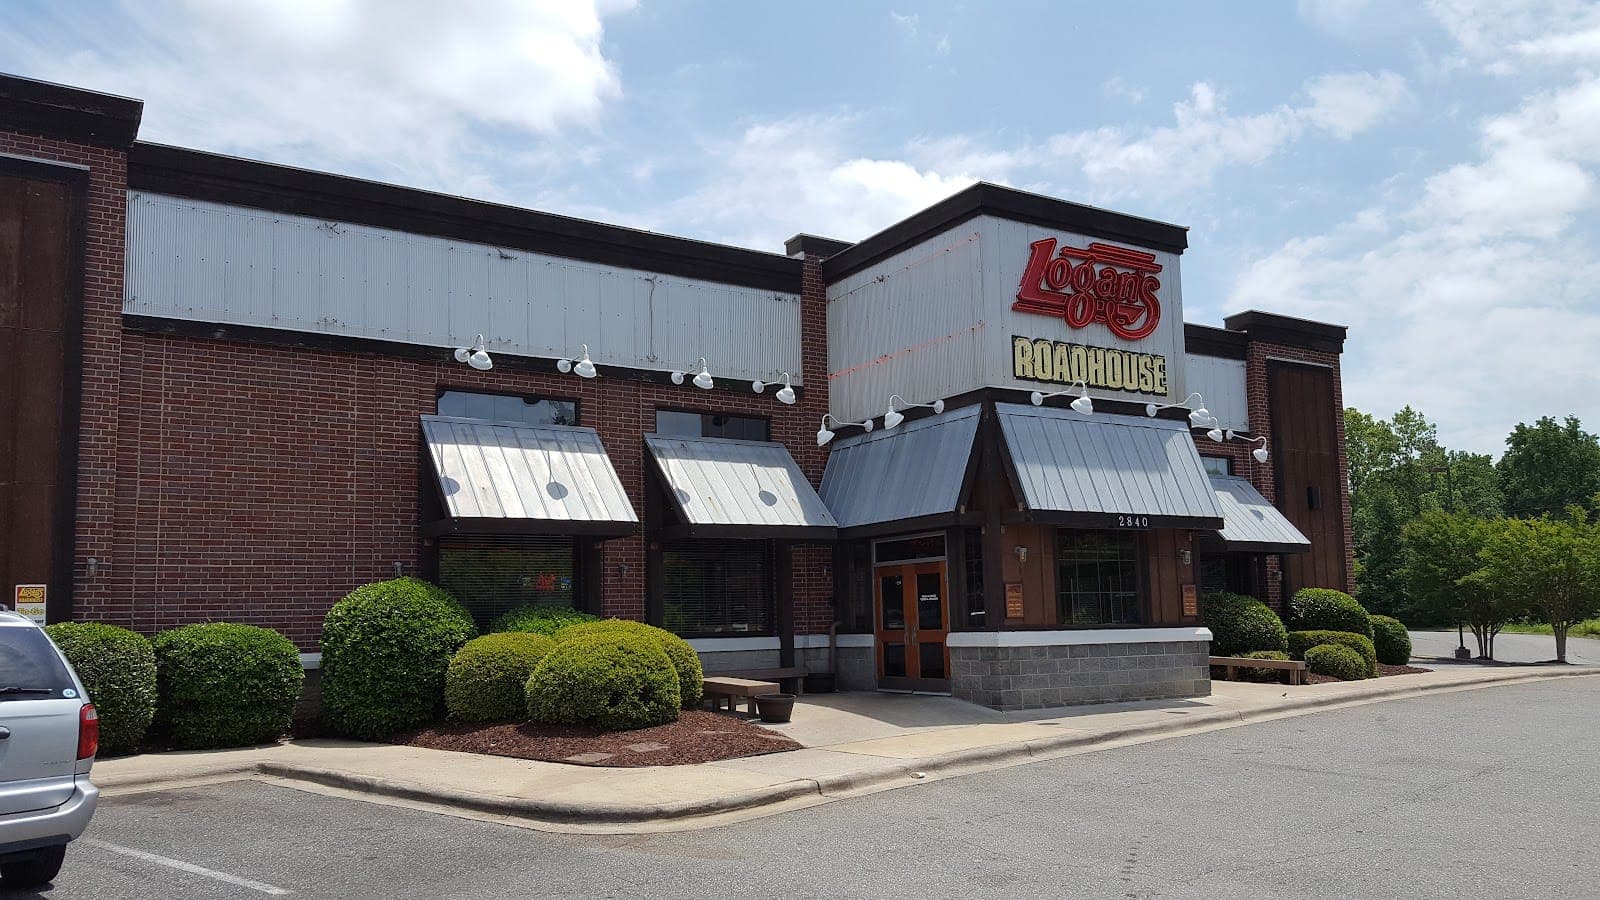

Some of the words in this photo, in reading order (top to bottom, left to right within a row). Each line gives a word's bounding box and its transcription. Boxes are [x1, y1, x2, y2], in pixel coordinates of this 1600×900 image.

[1012, 237, 1161, 340] Logan's
[1012, 336, 1167, 395] ROADHOUSE
[1118, 515, 1148, 527] 2840
